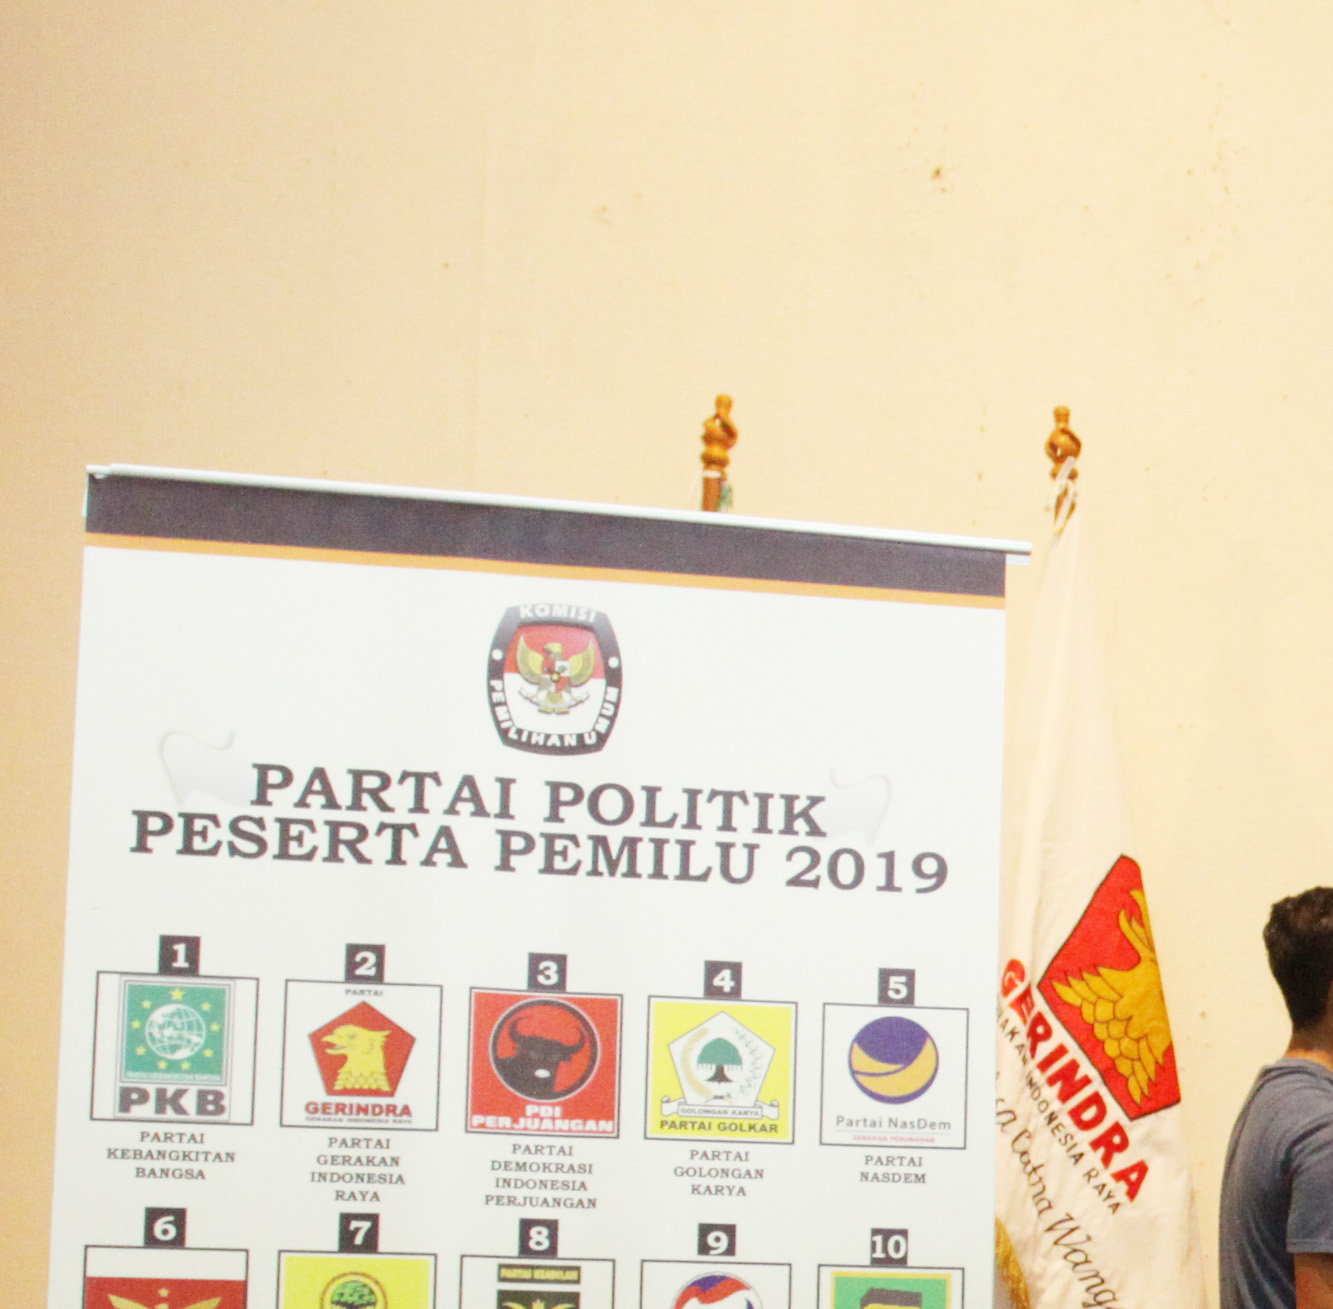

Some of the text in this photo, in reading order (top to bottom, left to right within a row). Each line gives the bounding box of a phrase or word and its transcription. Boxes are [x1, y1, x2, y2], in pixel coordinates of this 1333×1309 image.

[520, 603, 597, 622] KOMISI
[251, 763, 827, 838] PARTAI POLITIK
[129, 810, 948, 895] PESERTA PEMILU 2019
[354, 951, 377, 977] 2
[536, 961, 559, 985] 3
[712, 968, 736, 993] 4
[887, 976, 908, 1000] 5
[1000, 959, 1149, 1203] GERINDRA
[119, 1086, 226, 1117] PKB
[304, 1101, 413, 1117] GERINDRA
[525, 1104, 562, 1118] PDI
[471, 1115, 614, 1132] PERJUANGAN
[660, 1120, 778, 1134] PARTAI GOLKAR
[836, 1115, 951, 1131] Partai NasDem
[139, 1131, 205, 1144] PARTAI
[328, 1137, 391, 1149] PARTAI
[1025, 1071, 1121, 1215] INDONESIA RAYA
[106, 1148, 235, 1163] KEBANGKITAN
[512, 1143, 574, 1156] PARTAI
[689, 1149, 750, 1162] PARTAI
[317, 1154, 400, 1167] GERAKAN
[490, 1160, 593, 1174] DEMOKRASI
[864, 1155, 923, 1167] PARTAI
[135, 1167, 206, 1180] BANGSA
[310, 1171, 405, 1185] INDONESIA
[673, 1166, 764, 1180] GOLONGAN
[859, 1171, 926, 1184] NASDEM
[495, 1177, 588, 1191] INDONESIA
[690, 1183, 747, 1196] KARYA
[334, 1189, 381, 1202] RAYA
[484, 1195, 597, 1210] PERJUANGAN
[871, 1234, 907, 1259] 10
